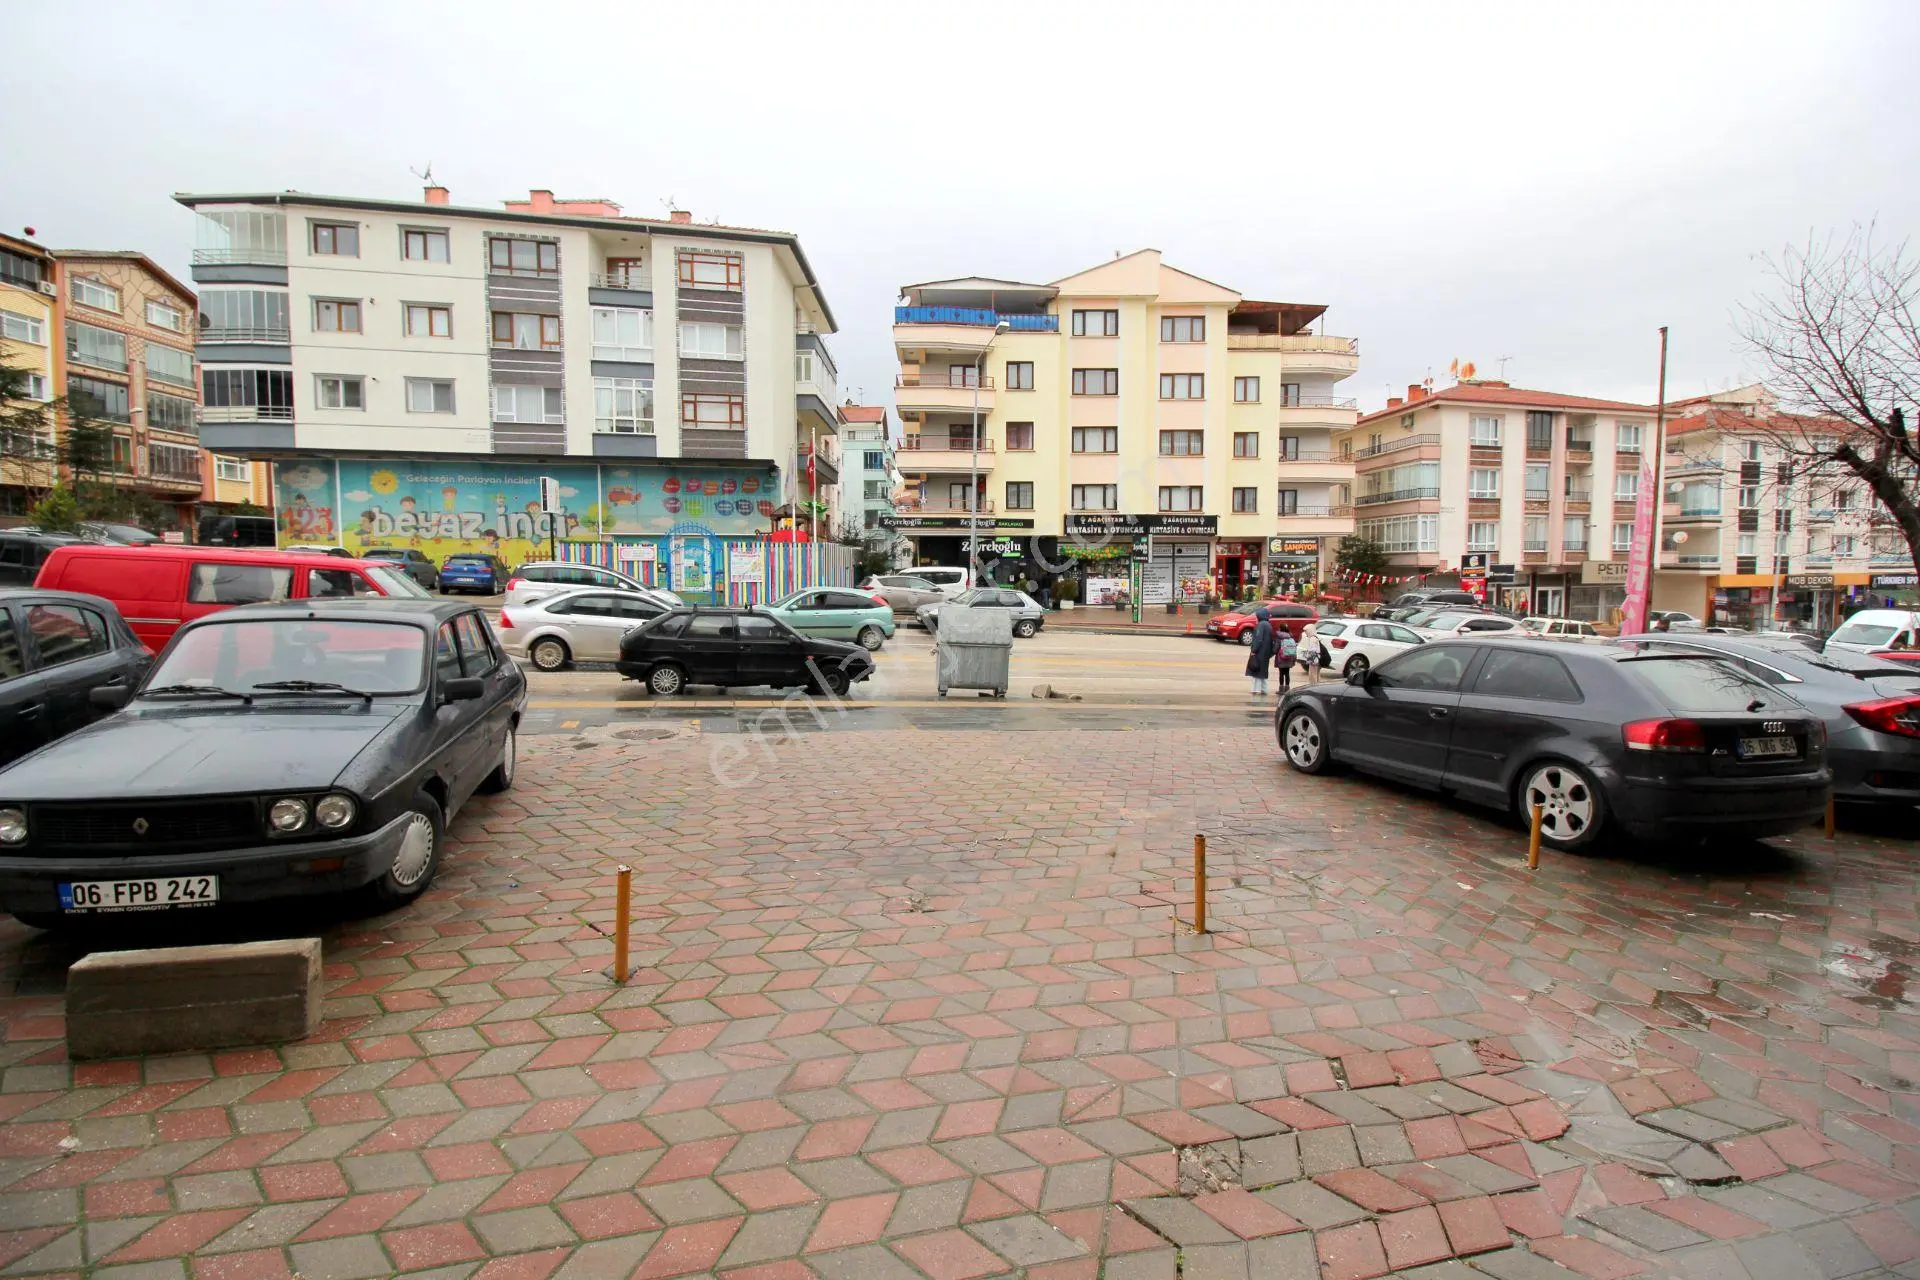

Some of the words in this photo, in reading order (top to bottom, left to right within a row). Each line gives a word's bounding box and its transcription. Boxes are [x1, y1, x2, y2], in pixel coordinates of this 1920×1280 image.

[458, 475, 502, 484] Parlayan
[373, 505, 485, 539] beyaz
[496, 505, 567, 539] inci
[1066, 525, 1102, 534] KIRTASİYE
[1110, 526, 1144, 534] OYUNCAK
[1149, 525, 1180, 534] KIRTASİYE
[1186, 526, 1216, 534] OYUNCAK
[961, 540, 1022, 554] Zyrekoğlu
[1807, 576, 1833, 585] DEKOR
[1877, 575, 1906, 585] TÜRKMEN
[1906, 576, 1919, 585] SPO
[72, 884, 102, 906] 06
[113, 881, 158, 904] FPB
[167, 878, 211, 901] 242
